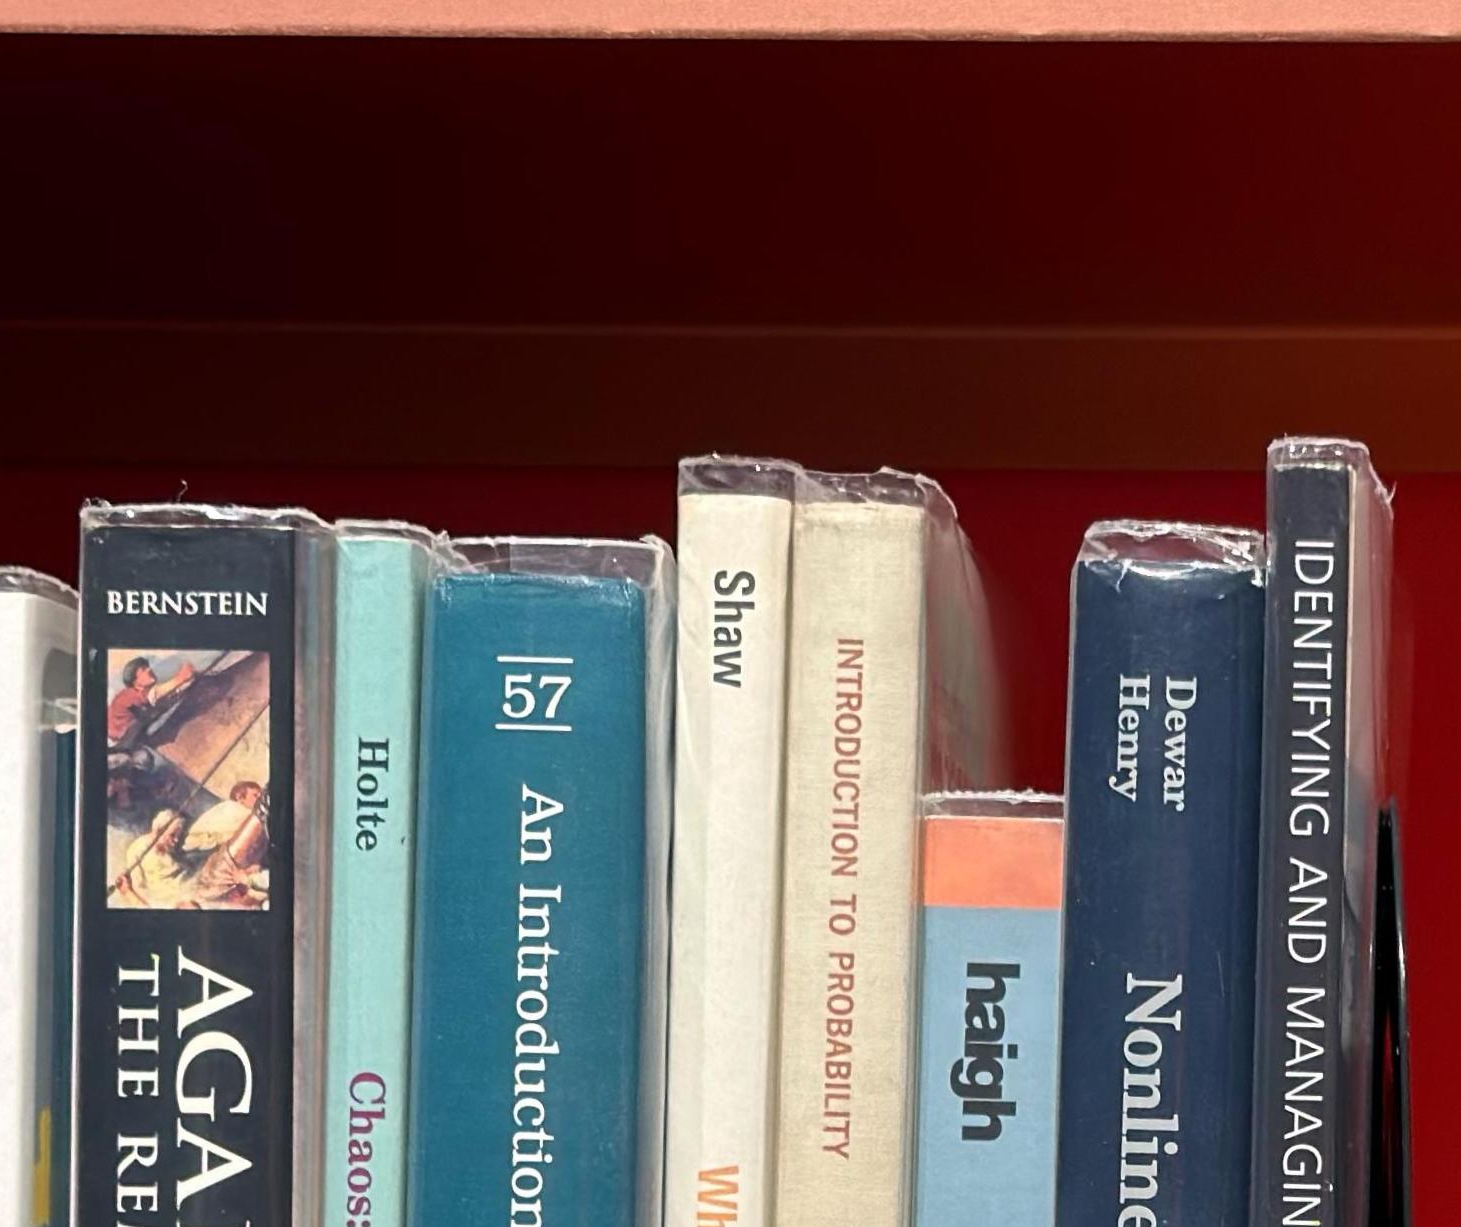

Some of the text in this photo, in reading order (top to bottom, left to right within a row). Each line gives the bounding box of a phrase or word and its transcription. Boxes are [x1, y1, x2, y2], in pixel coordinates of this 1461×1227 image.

[106, 590, 268, 618] BERNSTEIN
[713, 569, 755, 689] Shaw
[501, 674, 572, 719] 57
[1109, 673, 1150, 802] Henry
[1162, 675, 1198, 811] Dewar
[1288, 540, 1335, 838] IDENTIFYING
[355, 736, 390, 852] Holte
[520, 784, 564, 865] An
[821, 637, 866, 1161] INTRODUCTION TO PROBABILITY
[1286, 857, 1329, 965] AND
[116, 954, 161, 1098] THE
[950, 961, 1021, 1143] haigh
[345, 1071, 388, 1227] Chaos:
